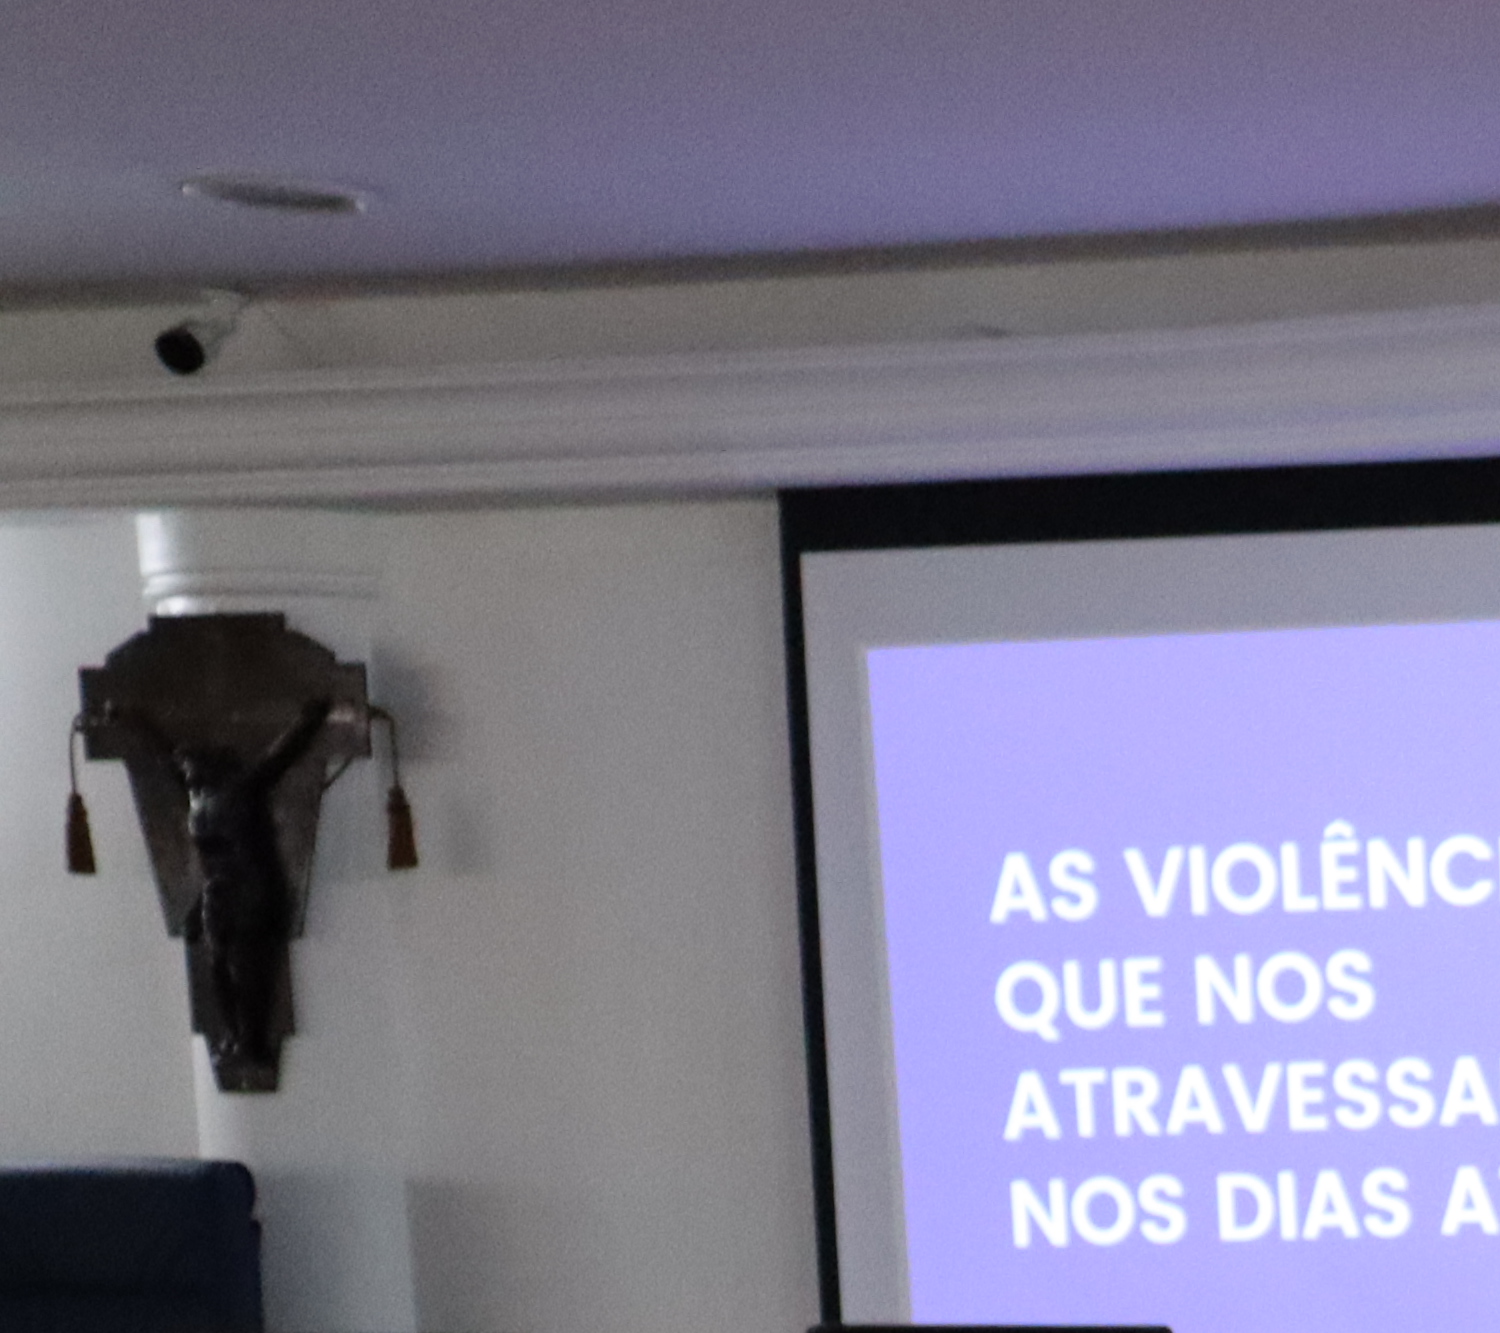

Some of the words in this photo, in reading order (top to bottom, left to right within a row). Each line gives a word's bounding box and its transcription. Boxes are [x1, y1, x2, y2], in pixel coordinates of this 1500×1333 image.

[990, 850, 1100, 924] AS
[995, 957, 1165, 1041] QUE
[1195, 949, 1376, 1025] NOS
[1010, 1175, 1189, 1249] NOS
[1216, 1167, 1412, 1242] DIAS
